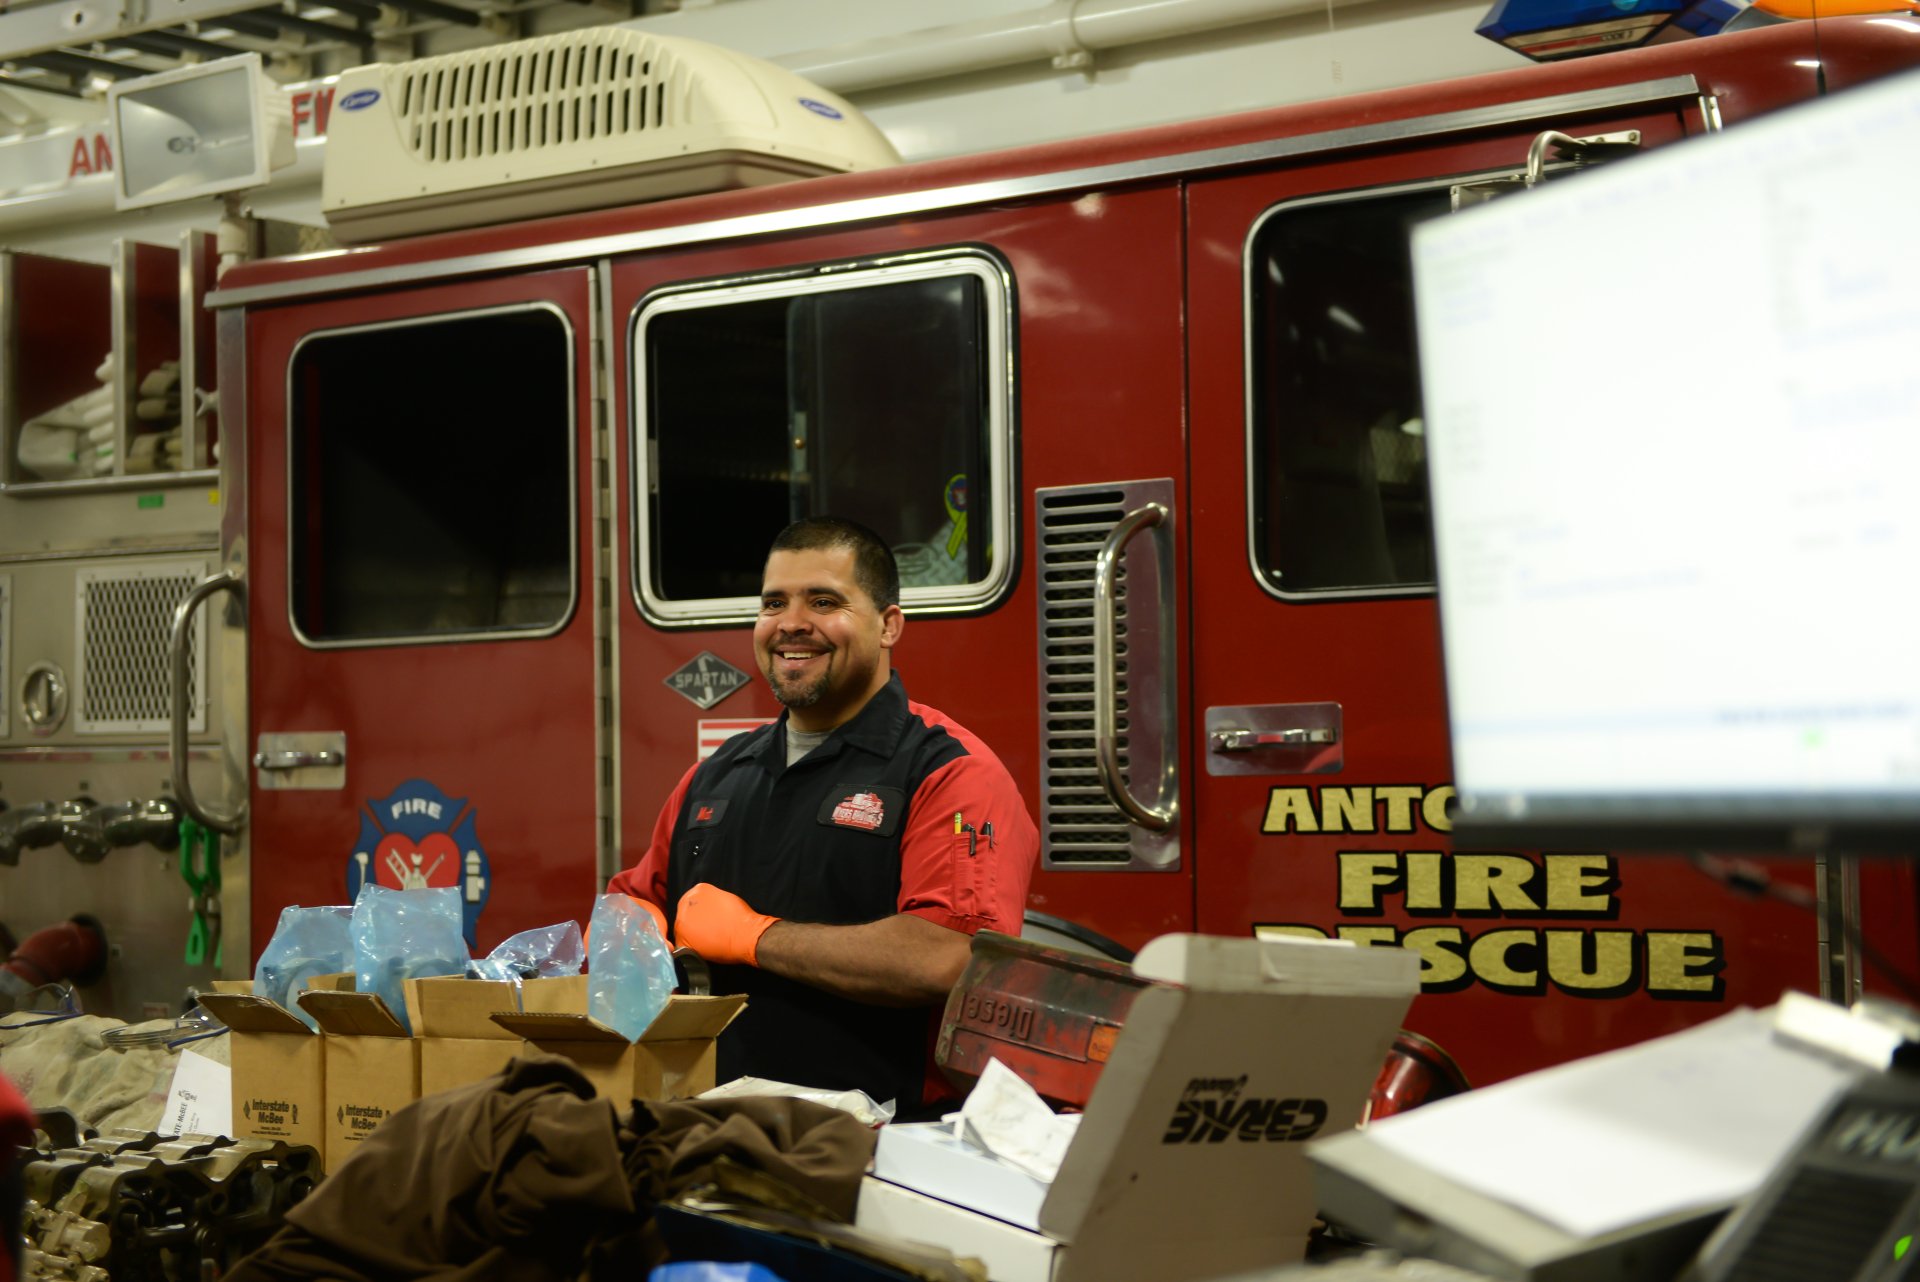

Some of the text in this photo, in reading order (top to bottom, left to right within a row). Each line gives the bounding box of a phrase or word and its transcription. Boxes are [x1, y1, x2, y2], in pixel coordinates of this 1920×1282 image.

[291, 87, 336, 138] FI
[674, 670, 738, 689] SPARTAN
[390, 797, 442, 820] FIRE
[1337, 852, 1616, 914] FIRE
[1254, 925, 1720, 995] SCUE
[957, 992, 1035, 1042] Diesel
[252, 1098, 290, 1113] Interstate
[345, 1103, 383, 1119] Interstate
[257, 1111, 285, 1124] McBee
[351, 1116, 377, 1131] McBee
